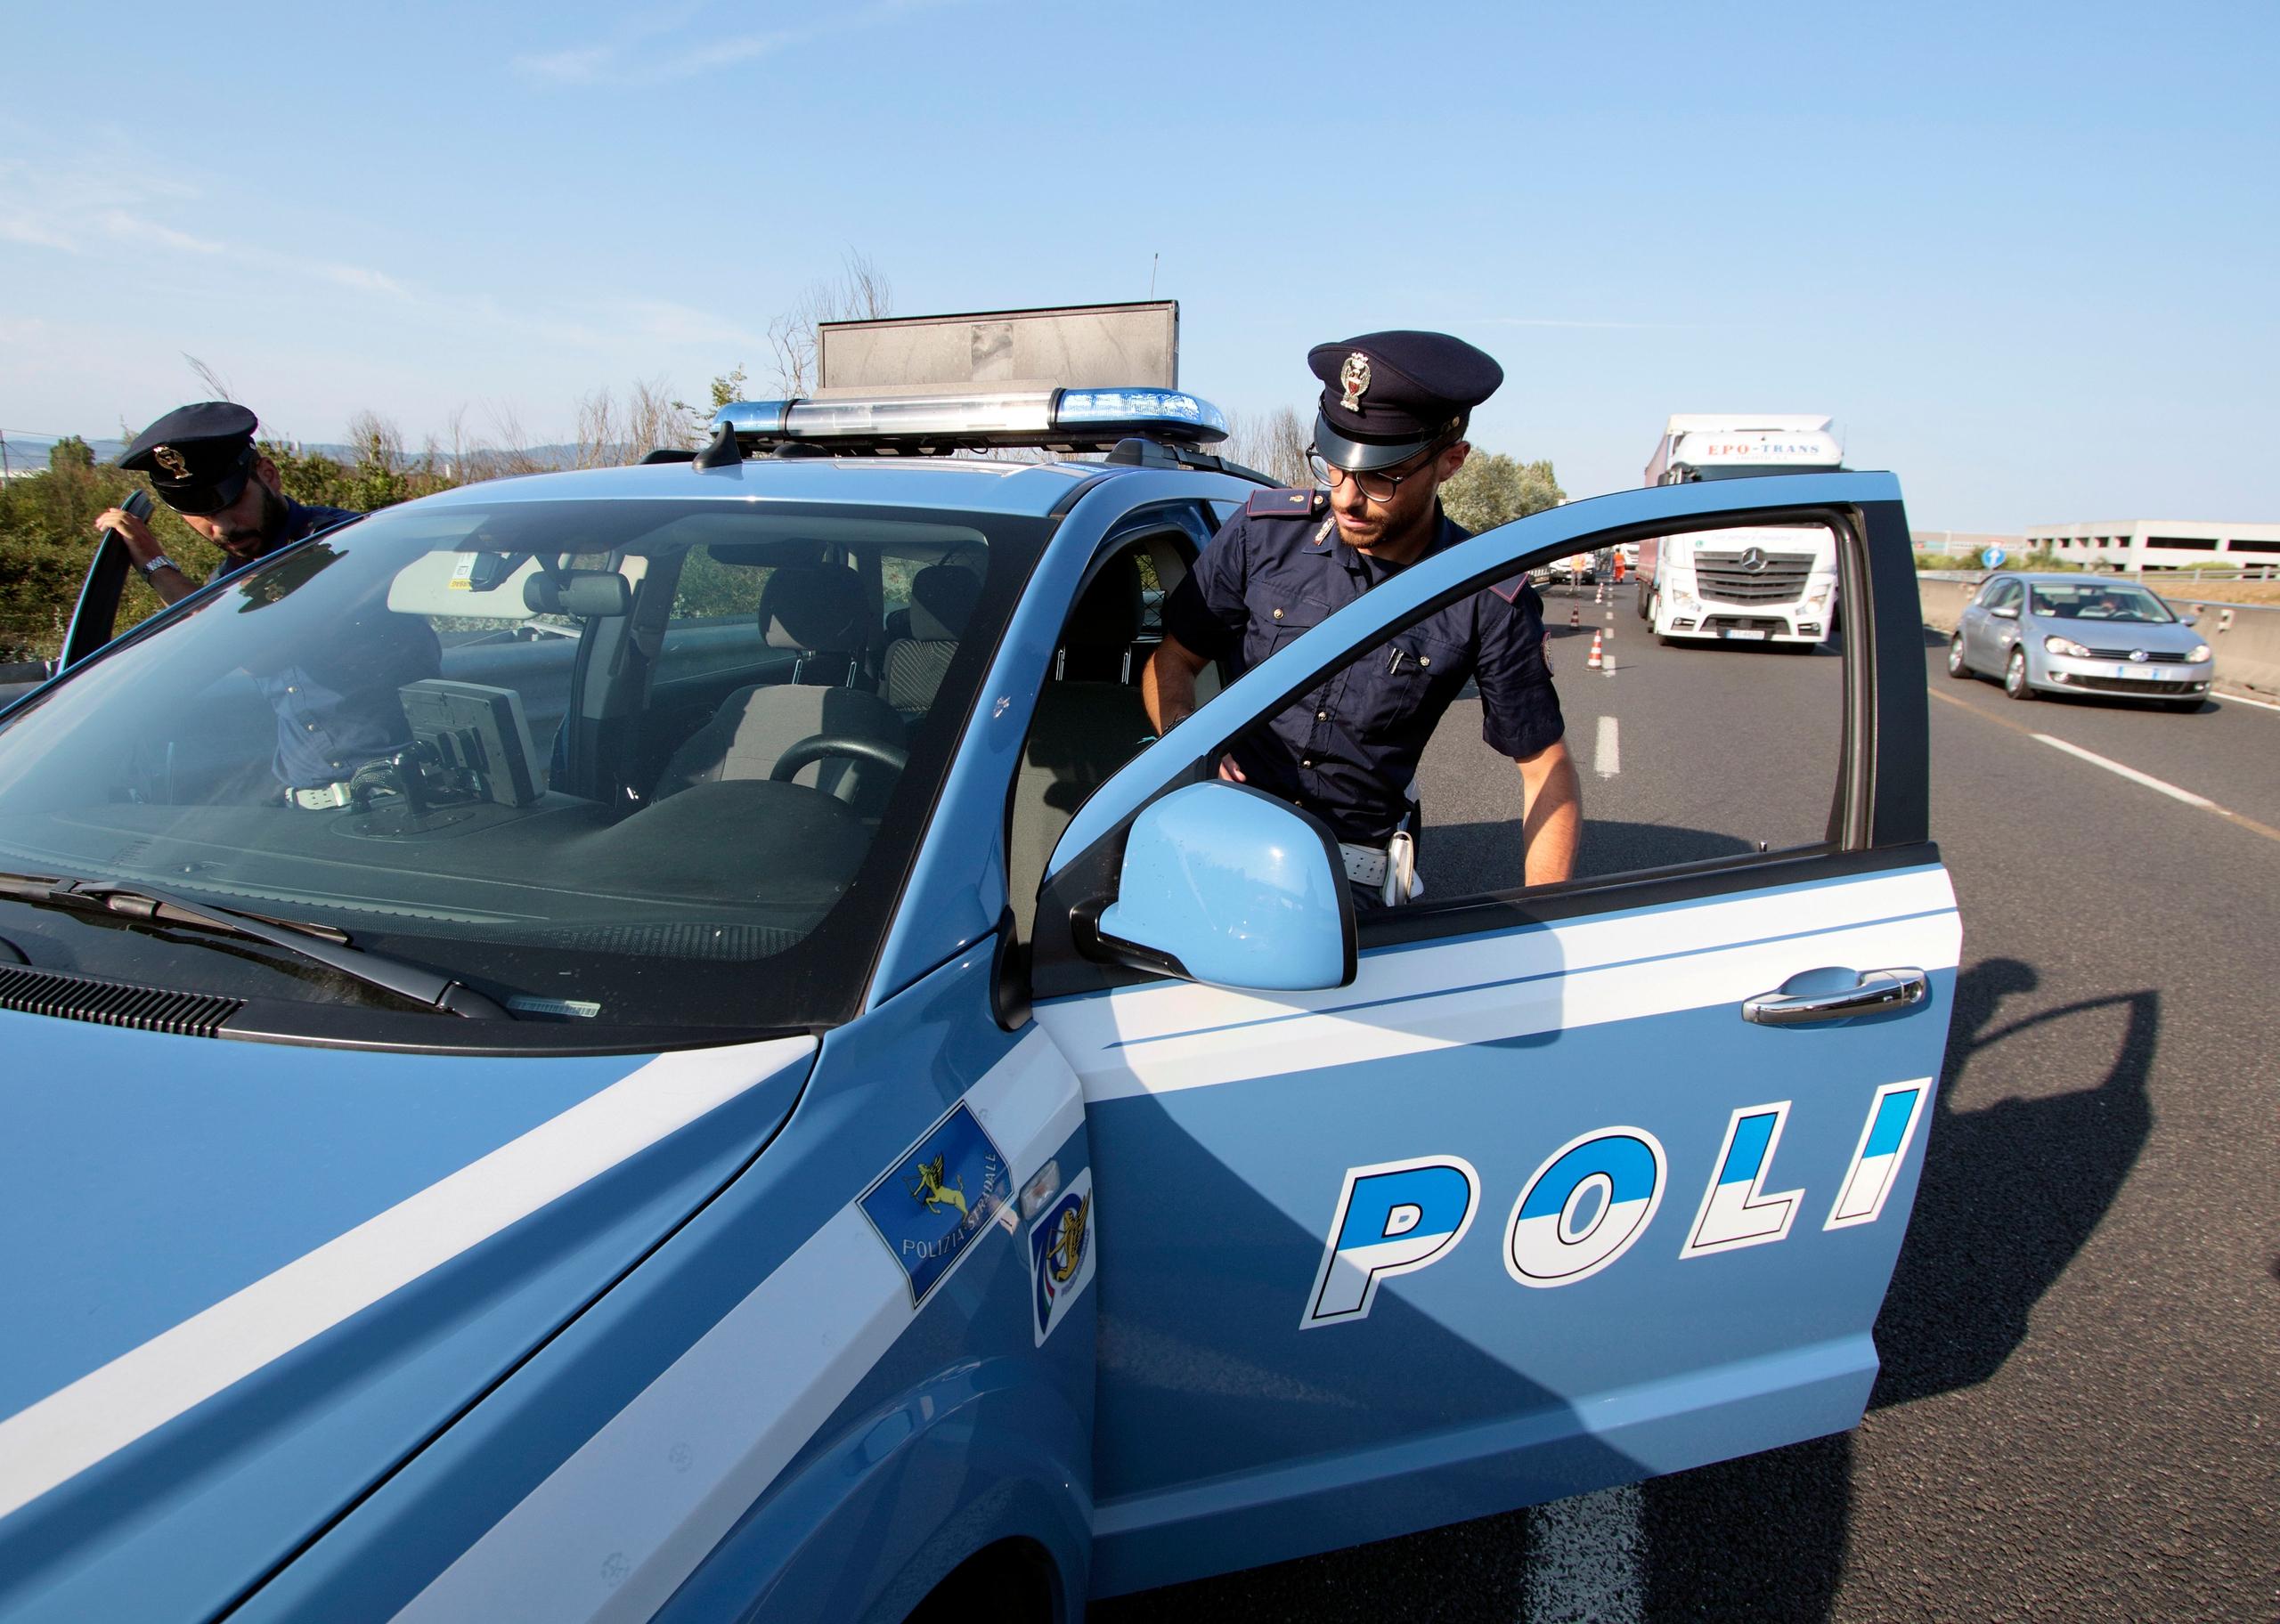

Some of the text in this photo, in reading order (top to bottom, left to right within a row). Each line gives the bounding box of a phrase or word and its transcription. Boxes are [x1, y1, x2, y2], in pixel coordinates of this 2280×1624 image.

[1708, 444, 1819, 455] EPO-TRANS
[902, 1154, 997, 1259] POLIZIA STRADALE
[1299, 1076, 1933, 1330] POLI
